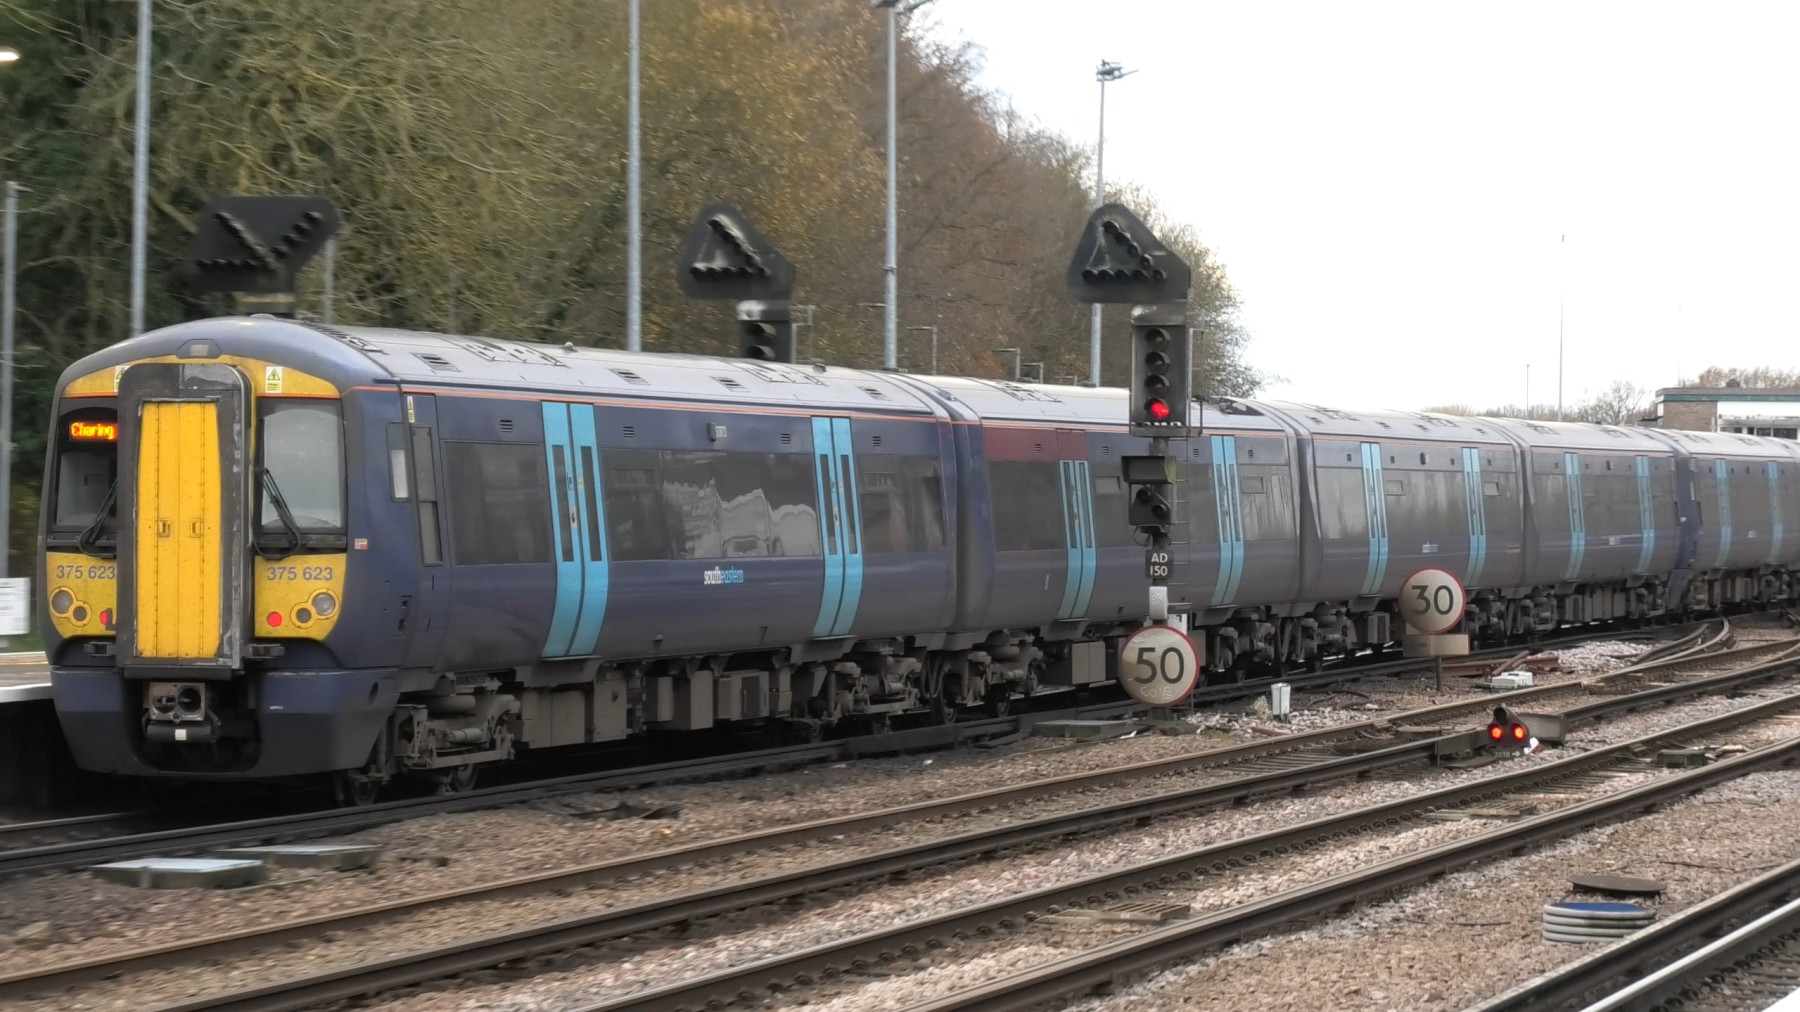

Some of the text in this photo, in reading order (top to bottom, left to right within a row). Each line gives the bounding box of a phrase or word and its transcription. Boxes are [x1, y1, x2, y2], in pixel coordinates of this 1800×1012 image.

[71, 422, 114, 440] Charing
[1151, 553, 1168, 563] AD
[56, 565, 116, 579] 375 623
[267, 566, 333, 581] 375 623
[703, 565, 744, 585] southeastern
[1150, 565, 1168, 576] 150
[1411, 585, 1454, 615] 30
[1134, 647, 1184, 684] 50
